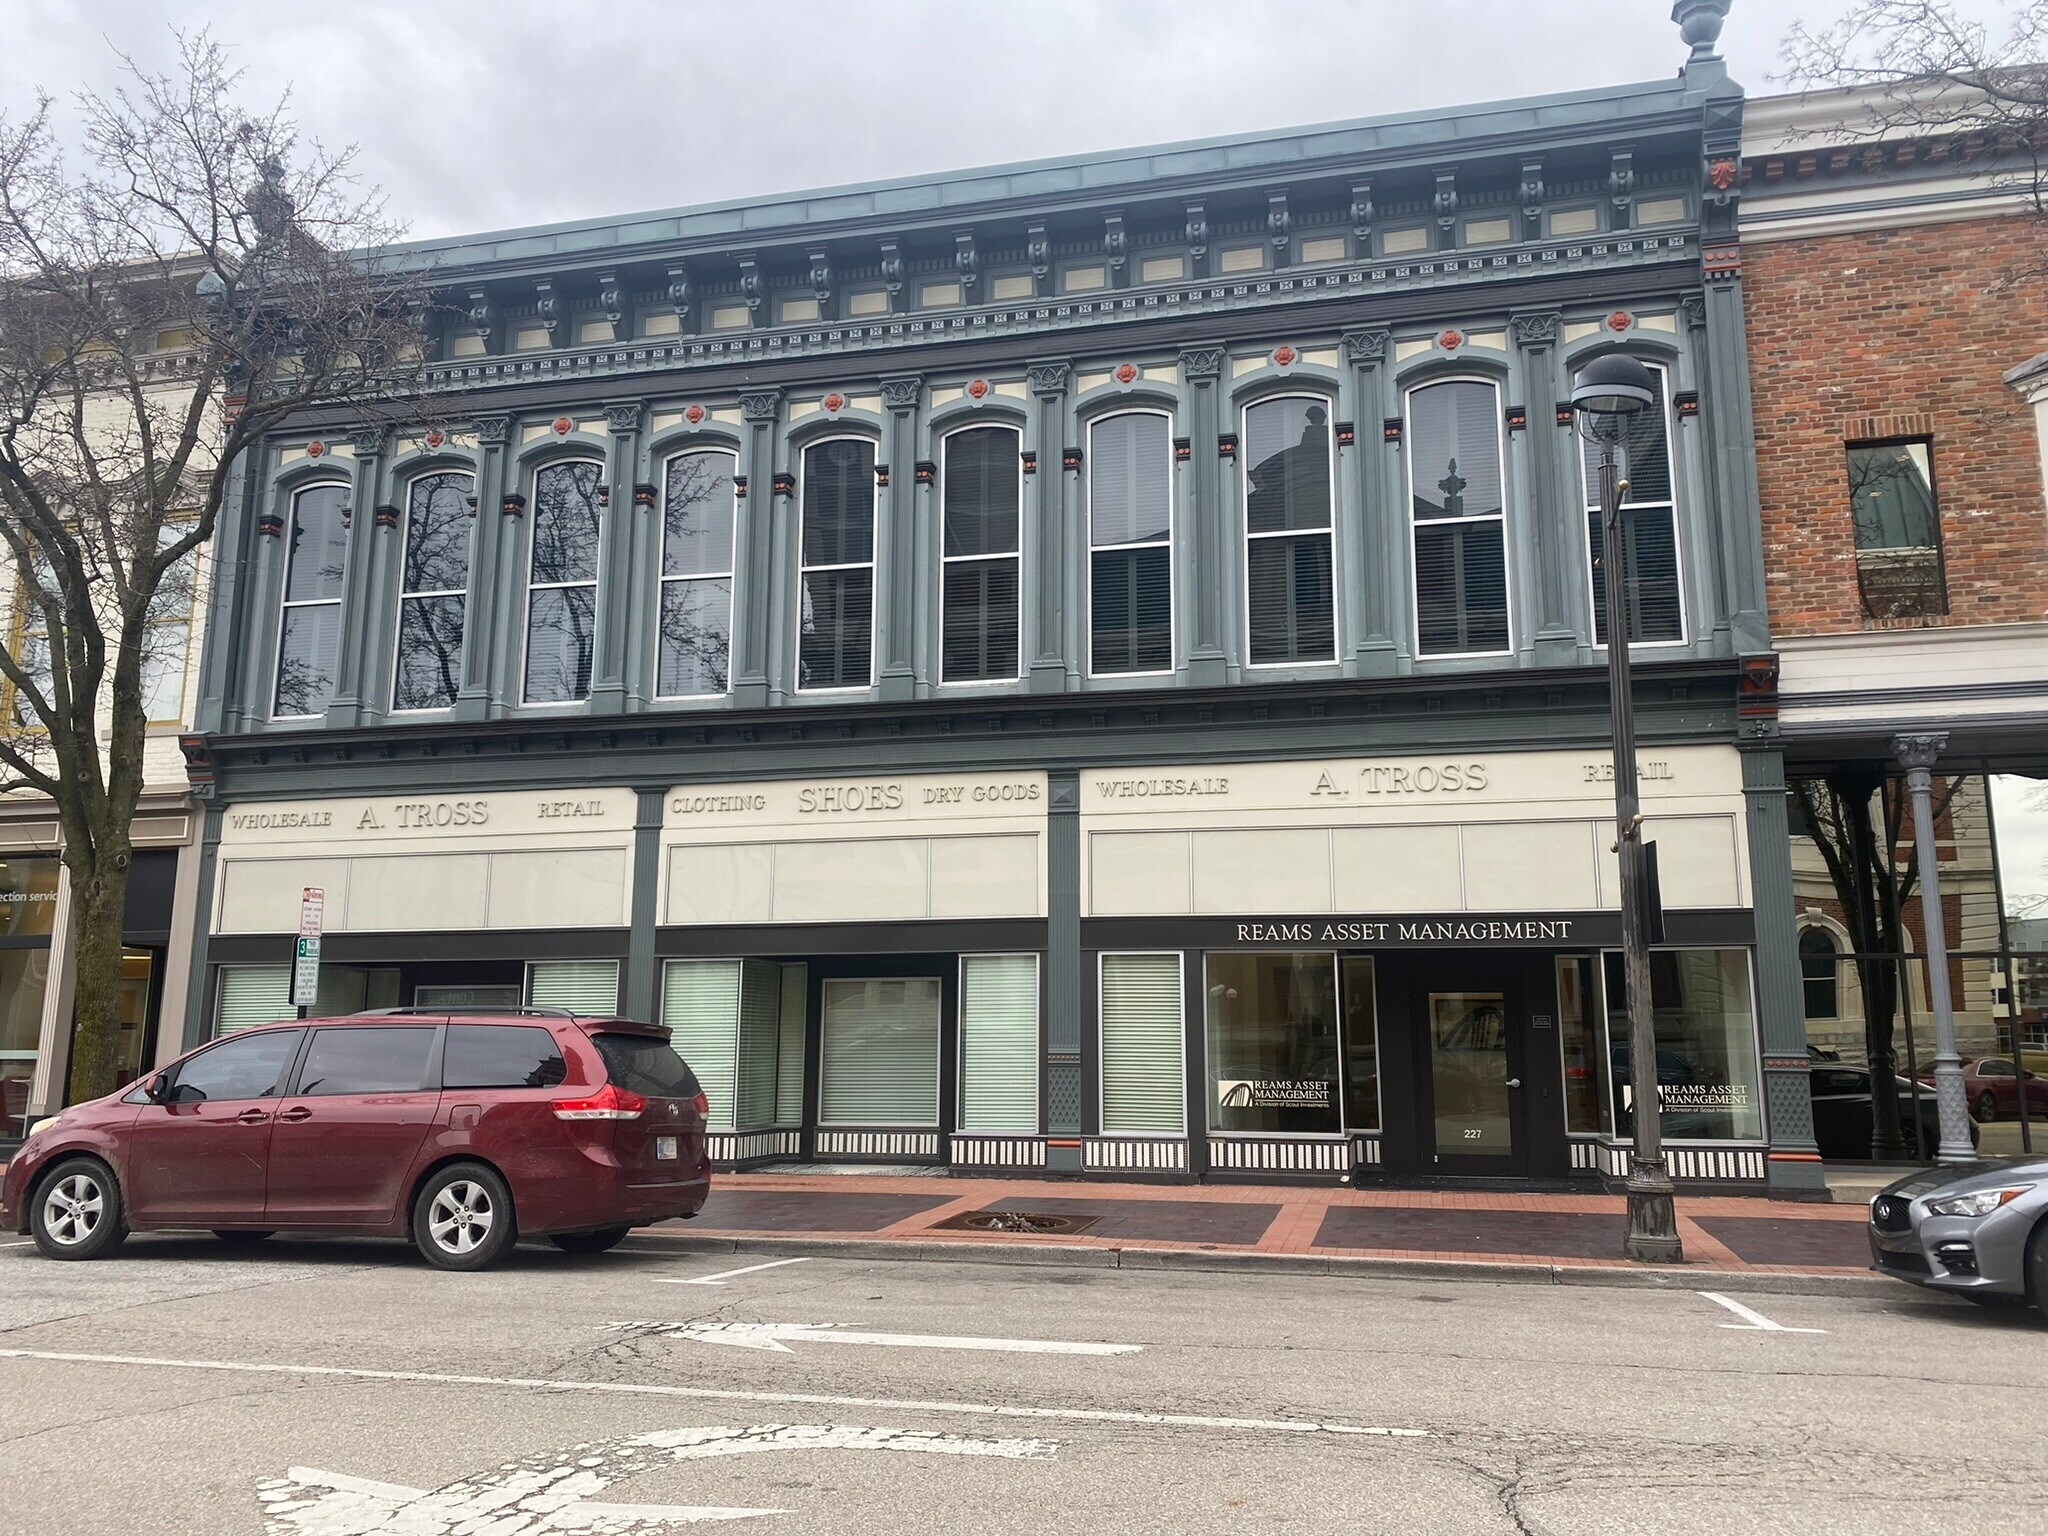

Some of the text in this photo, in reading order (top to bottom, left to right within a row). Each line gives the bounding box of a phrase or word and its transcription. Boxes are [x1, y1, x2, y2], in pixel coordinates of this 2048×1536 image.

[1097, 762, 1674, 797] WHOLESALE A. TROSS REAIL
[670, 784, 1040, 814] CLOTHING SHOES DRY GOODS
[231, 800, 604, 829] WHOLESALE A. TROSS RETAIL
[1236, 921, 1573, 942] REAMS ASSET MANAGEMENT
[300, 940, 306, 954] 3
[1255, 1081, 1329, 1091] REAMS ASSET
[1664, 1085, 1747, 1095] REAMS ASSET
[1255, 1090, 1330, 1100] MANAGEMENT
[1664, 1095, 1748, 1105] MANAGEMENT
[1464, 1129, 1482, 1139] 227
